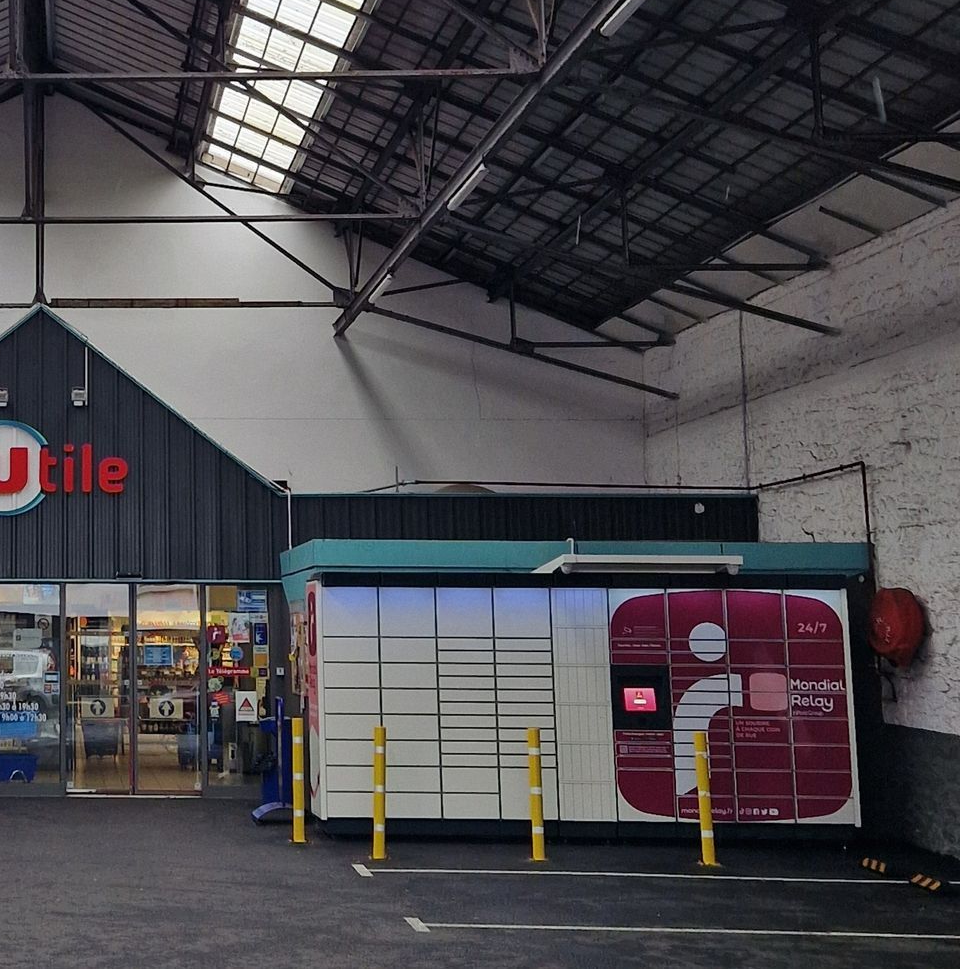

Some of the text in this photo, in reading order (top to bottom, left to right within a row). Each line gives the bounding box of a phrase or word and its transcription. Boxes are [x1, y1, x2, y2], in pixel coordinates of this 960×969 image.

[797, 621, 827, 634] 24/7
[790, 678, 846, 691] Mondial
[791, 694, 834, 712] Relay
[1, 712, 19, 722] 9h00
[681, 807, 733, 816] monelay.fr
